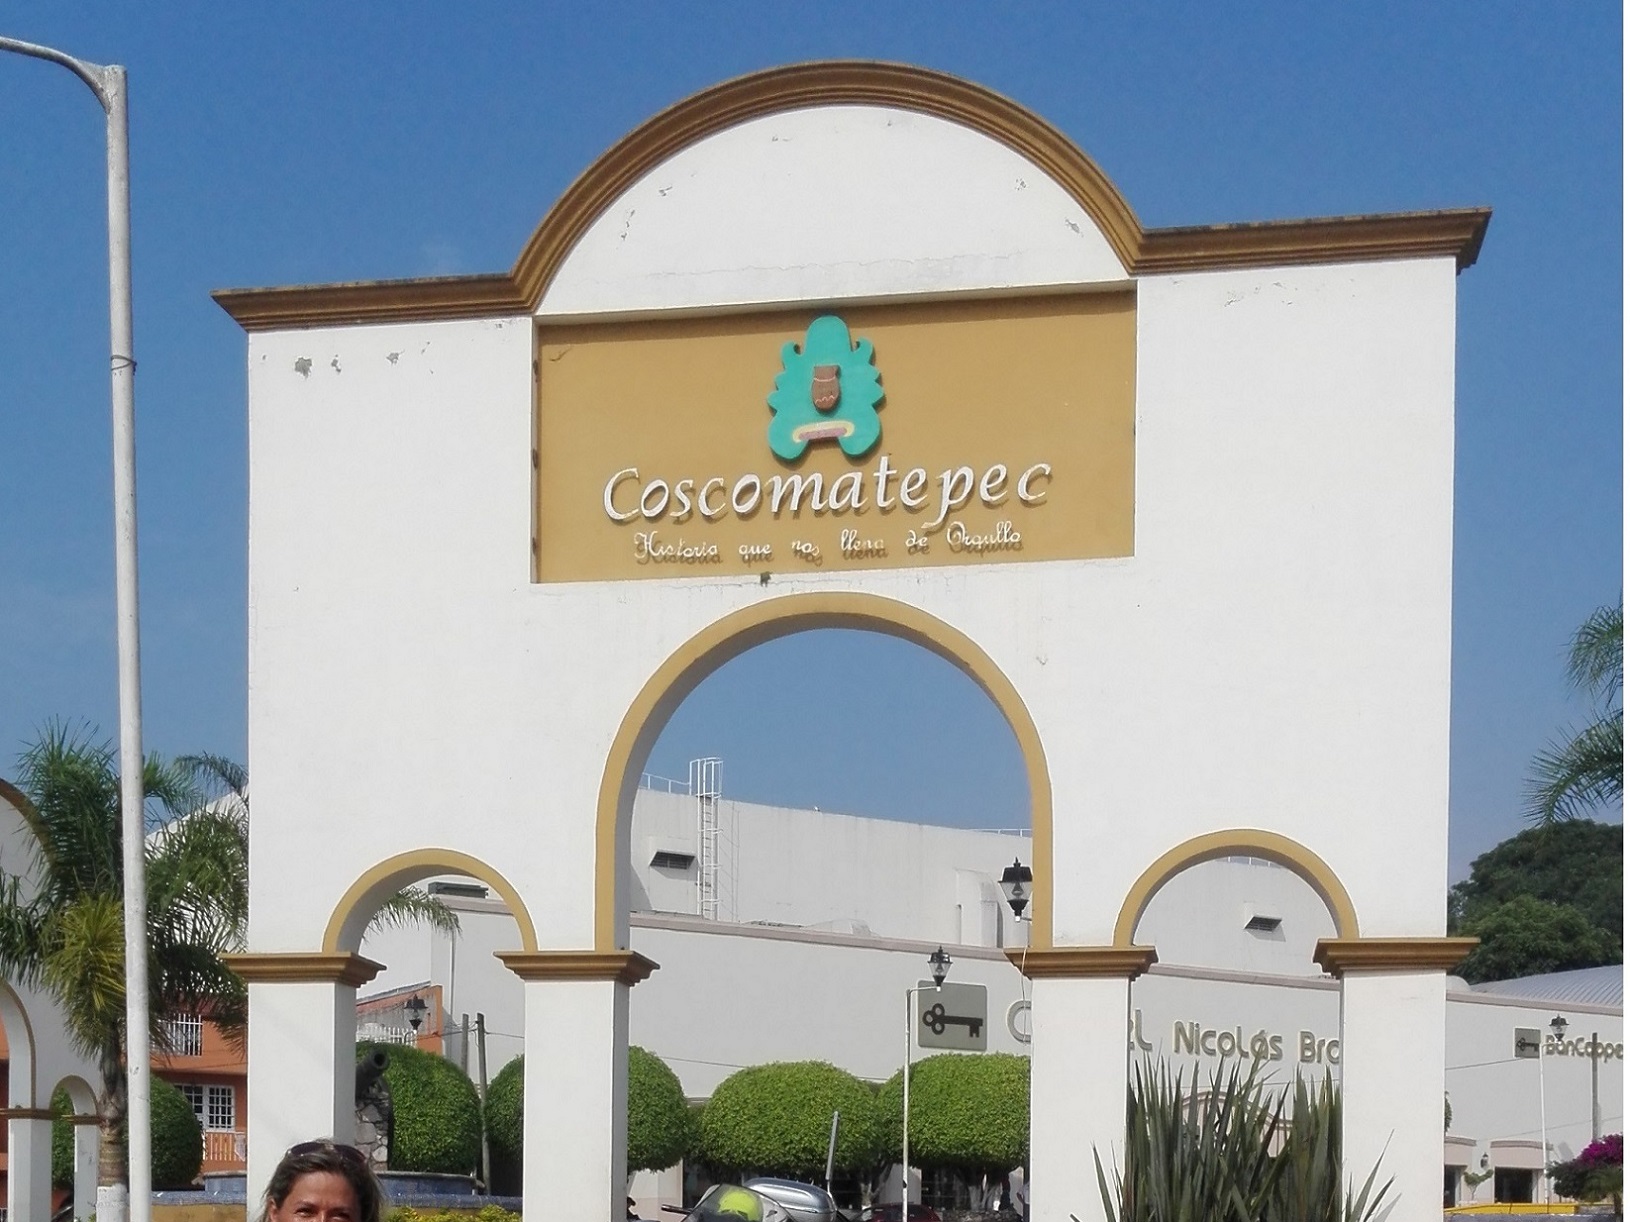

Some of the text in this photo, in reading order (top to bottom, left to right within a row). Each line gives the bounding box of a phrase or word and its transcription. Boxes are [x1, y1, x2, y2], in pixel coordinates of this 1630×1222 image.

[602, 455, 1052, 528] Coscomatepec
[633, 531, 719, 558] Historia
[738, 544, 772, 558] que
[791, 539, 820, 555] nos
[840, 529, 885, 551] llena
[905, 529, 928, 547] de
[1173, 1020, 1284, 1061] Nicolás
